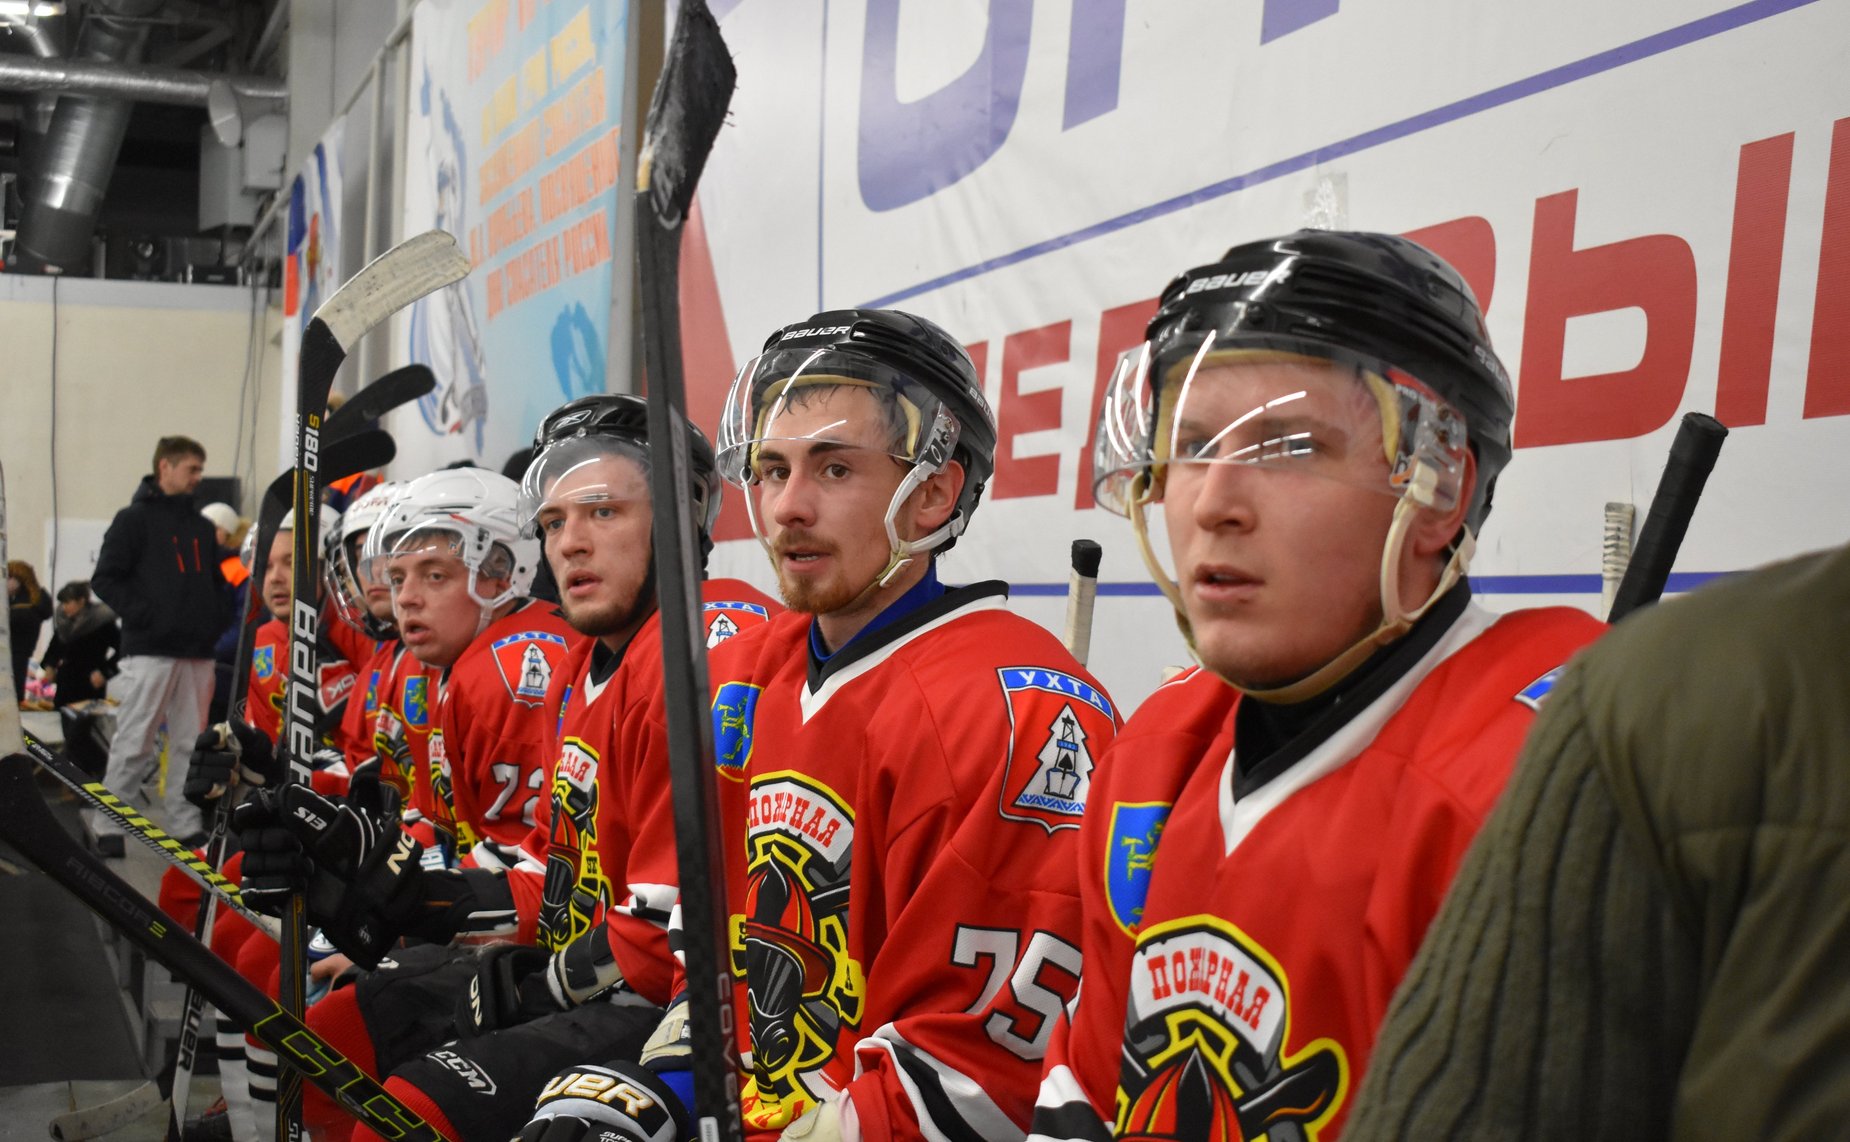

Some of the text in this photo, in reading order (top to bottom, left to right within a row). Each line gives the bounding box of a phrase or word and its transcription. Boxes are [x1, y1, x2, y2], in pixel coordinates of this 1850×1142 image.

[780, 326, 851, 341] BAUER
[705, 602, 754, 612] ХТА
[289, 599, 317, 787] BAUER
[1018, 671, 1103, 708] УХТА
[294, 806, 327, 831] S13
[950, 923, 1083, 1061] 75
[435, 1050, 486, 1087] CCM
